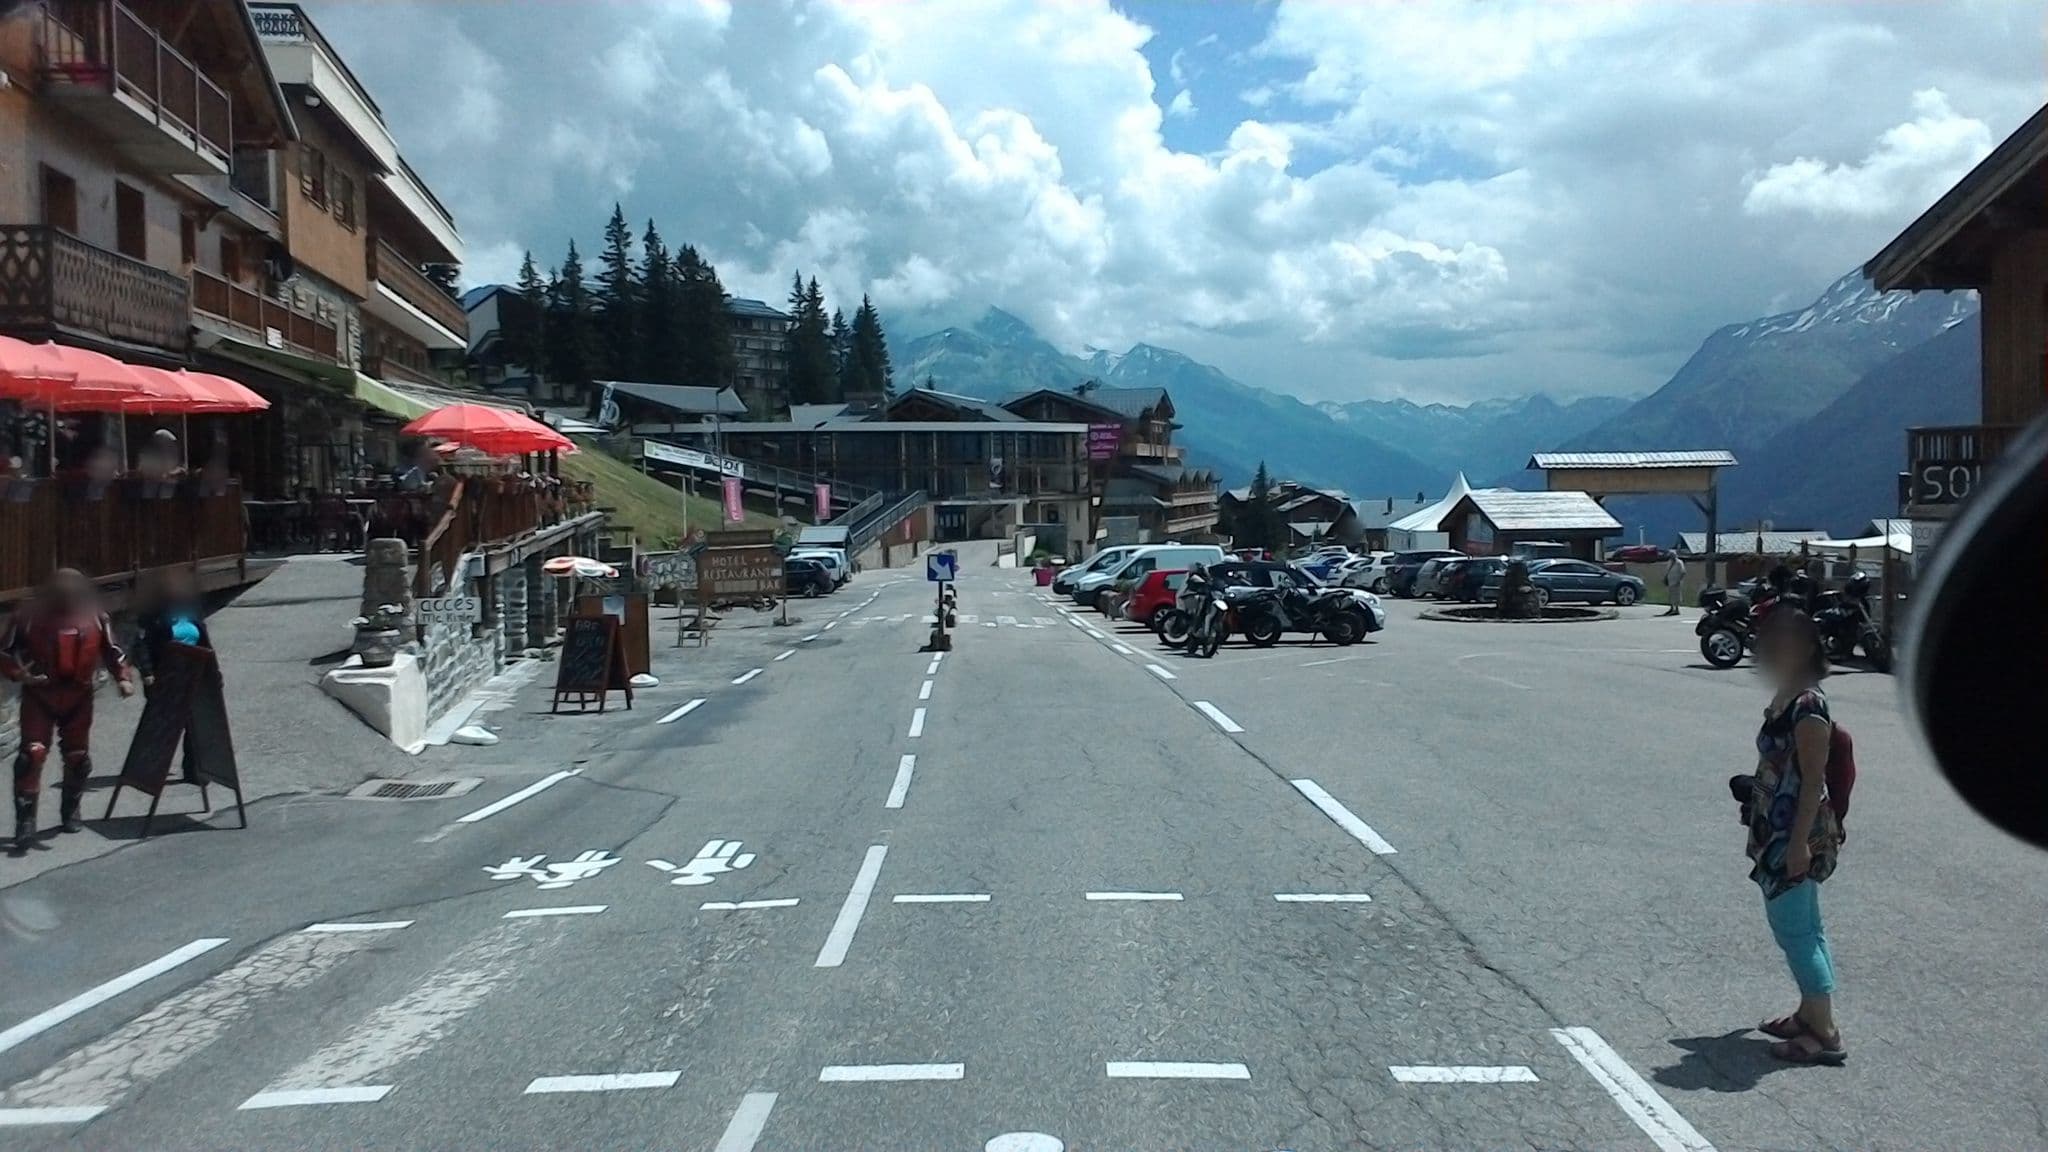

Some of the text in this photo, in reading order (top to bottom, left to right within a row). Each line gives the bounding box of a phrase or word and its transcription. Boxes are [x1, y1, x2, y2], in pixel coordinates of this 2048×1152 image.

[712, 554, 748, 567] HOTEL
[703, 567, 770, 580] RESTAURANT
[759, 579, 780, 591] BAR
